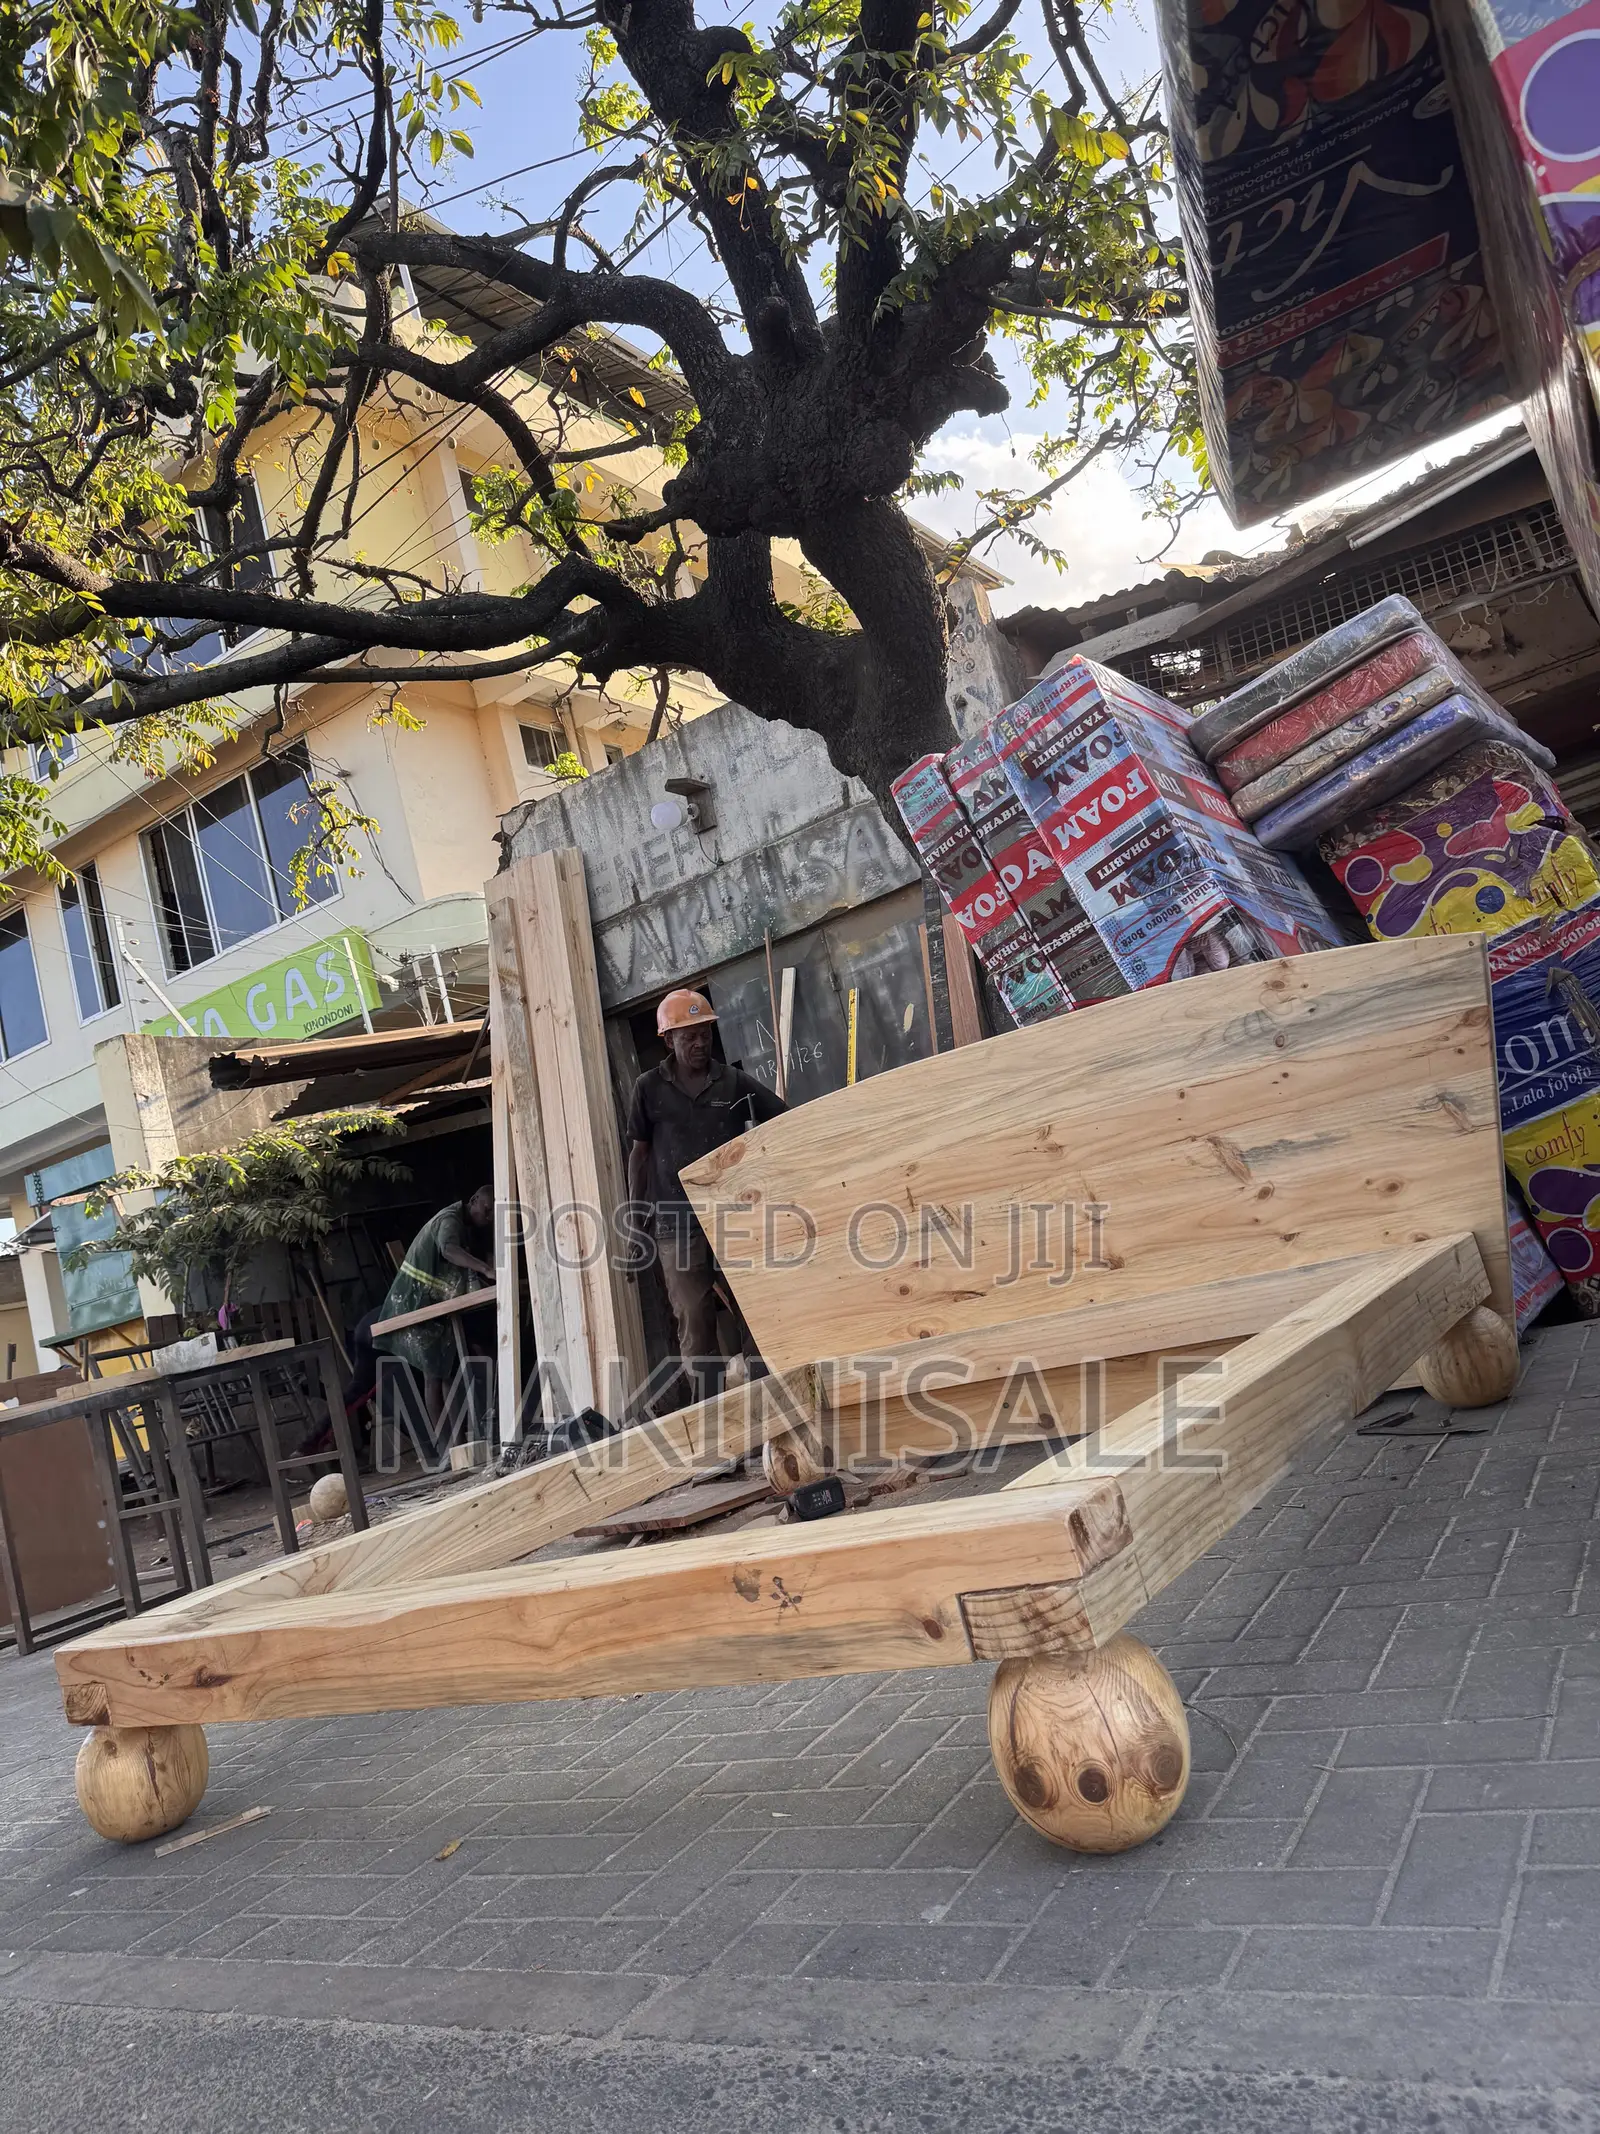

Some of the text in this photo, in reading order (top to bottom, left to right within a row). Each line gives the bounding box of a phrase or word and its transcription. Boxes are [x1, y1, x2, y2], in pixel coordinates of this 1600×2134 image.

[1339, 99, 1410, 143] BRANCHES:
[1083, 711, 1104, 727] YA
[1031, 724, 1084, 770] DHABITI
[1052, 768, 1148, 850] FOAM
[1150, 823, 1171, 840] YA
[1096, 836, 1151, 880] DHABITI
[1181, 878, 1218, 905] Kulalia
[1145, 904, 1182, 931] Godoro
[1120, 926, 1147, 947] Bora
[246, 951, 345, 1032] GAS
[303, 1003, 354, 1034] KINONDONI
[1524, 1111, 1588, 1166] comfy
